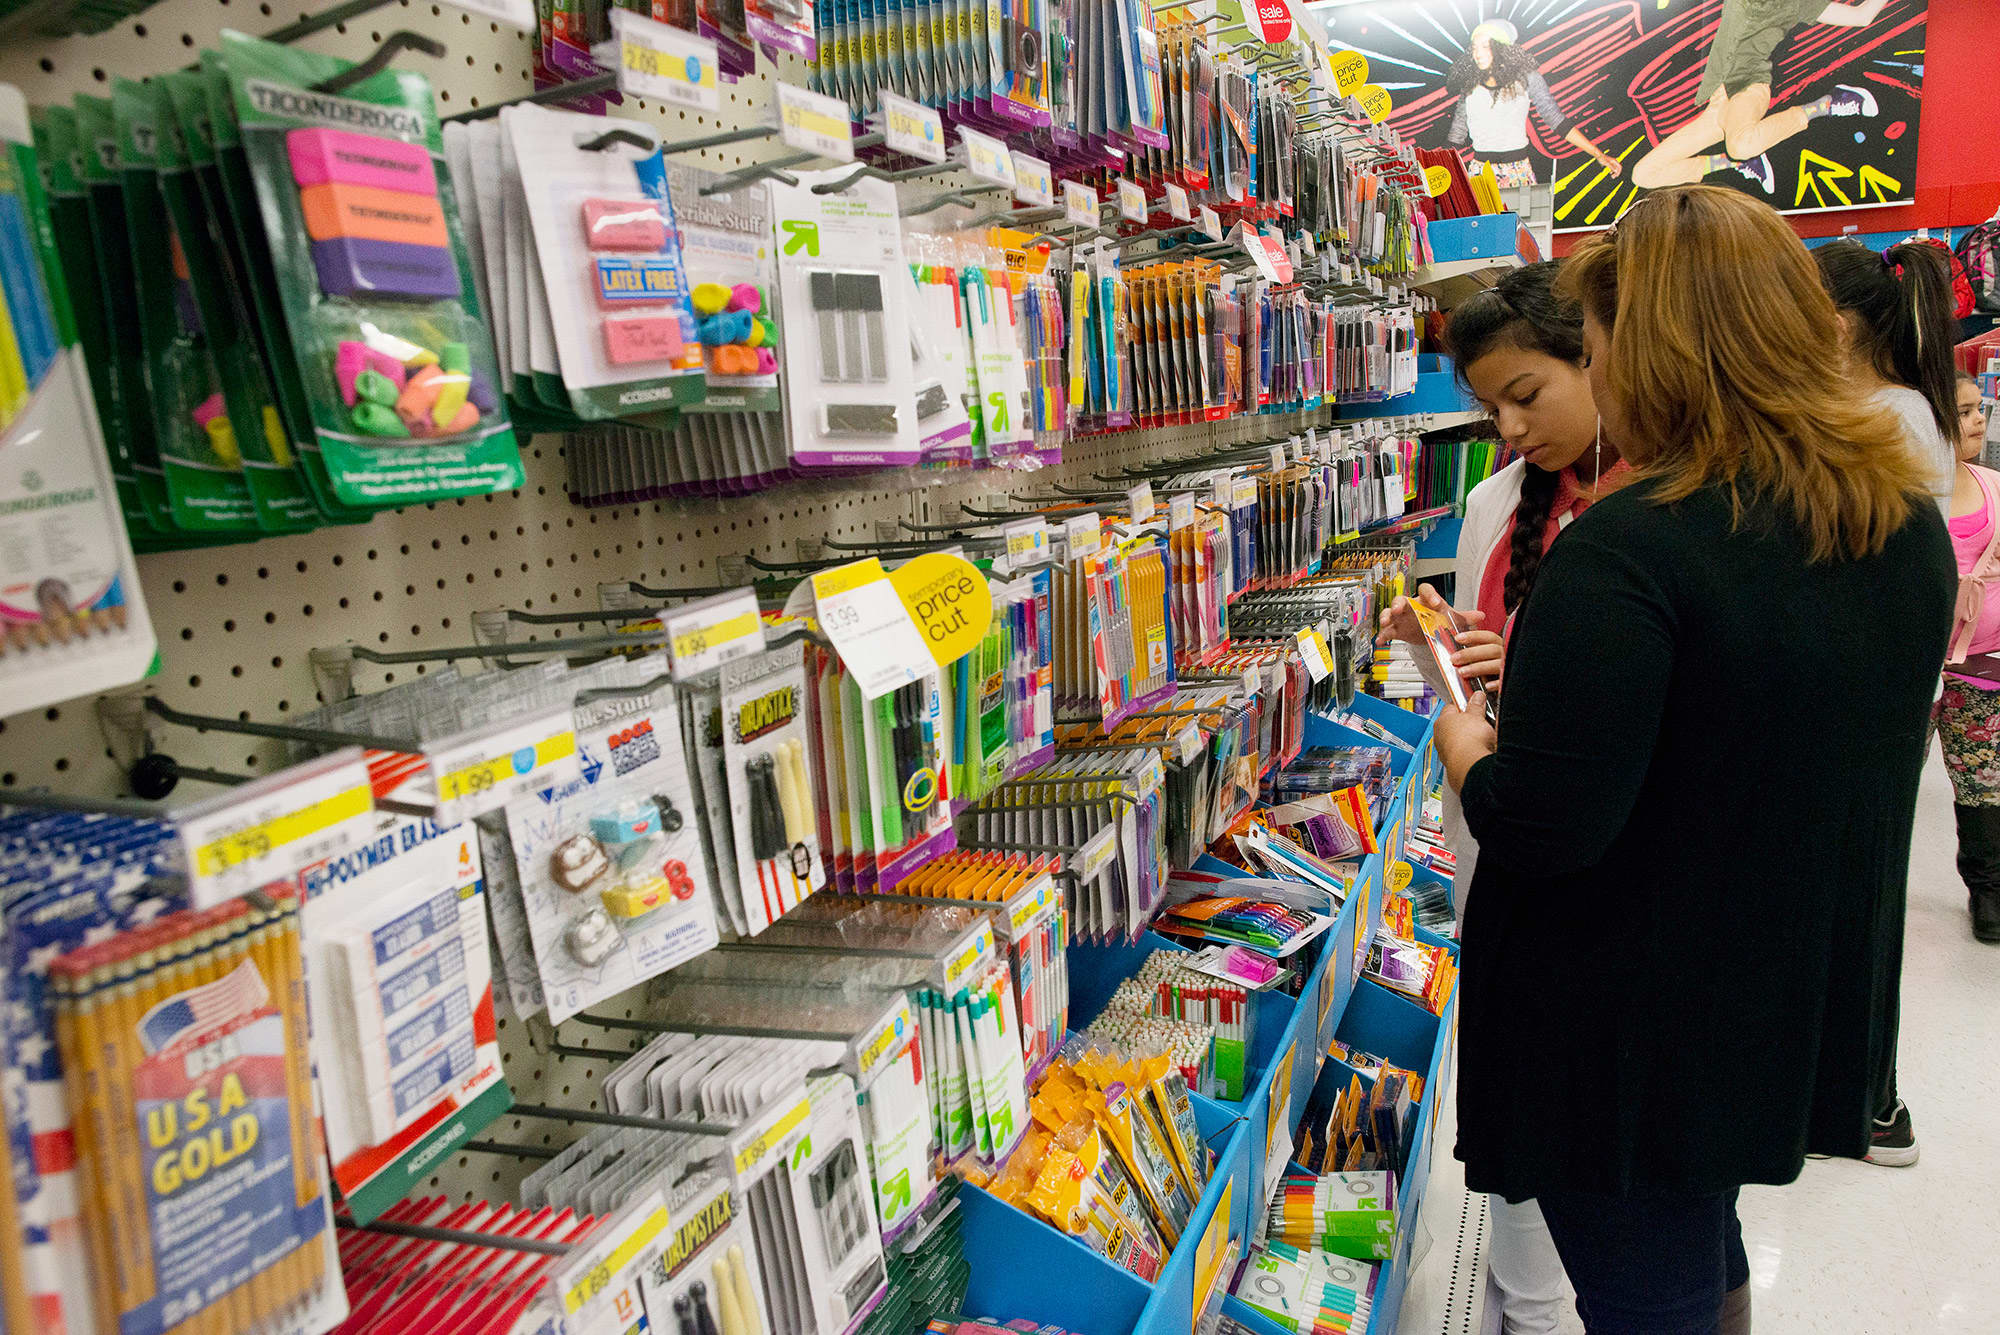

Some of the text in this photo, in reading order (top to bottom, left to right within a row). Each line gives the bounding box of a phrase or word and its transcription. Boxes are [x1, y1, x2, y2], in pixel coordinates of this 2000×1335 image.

[1260, 4, 1284, 19] sale
[1336, 59, 1363, 80] price
[1339, 73, 1358, 88] cut
[252, 86, 422, 135] TICONDEROGA
[1363, 91, 1386, 111] price
[1368, 104, 1385, 117] cut
[724, 212, 762, 234] Stuff
[1269, 248, 1285, 262] sale
[602, 269, 678, 292] LATEX FREE
[831, 453, 885, 464] MECHANICAL
[907, 565, 965, 603] temporary
[915, 576, 976, 626] price
[825, 605, 860, 630] 3.99
[927, 605, 970, 642] cut
[608, 717, 654, 751] ROCK
[400, 815, 463, 852] ERAS
[458, 841, 471, 865] 4
[152, 1113, 260, 1195] GOLD
[407, 1121, 467, 1175] ACCESSORIES
[663, 1189, 733, 1272] DRUMSTICK
[1106, 1226, 1123, 1258] BIC
[613, 1289, 632, 1315] 12
